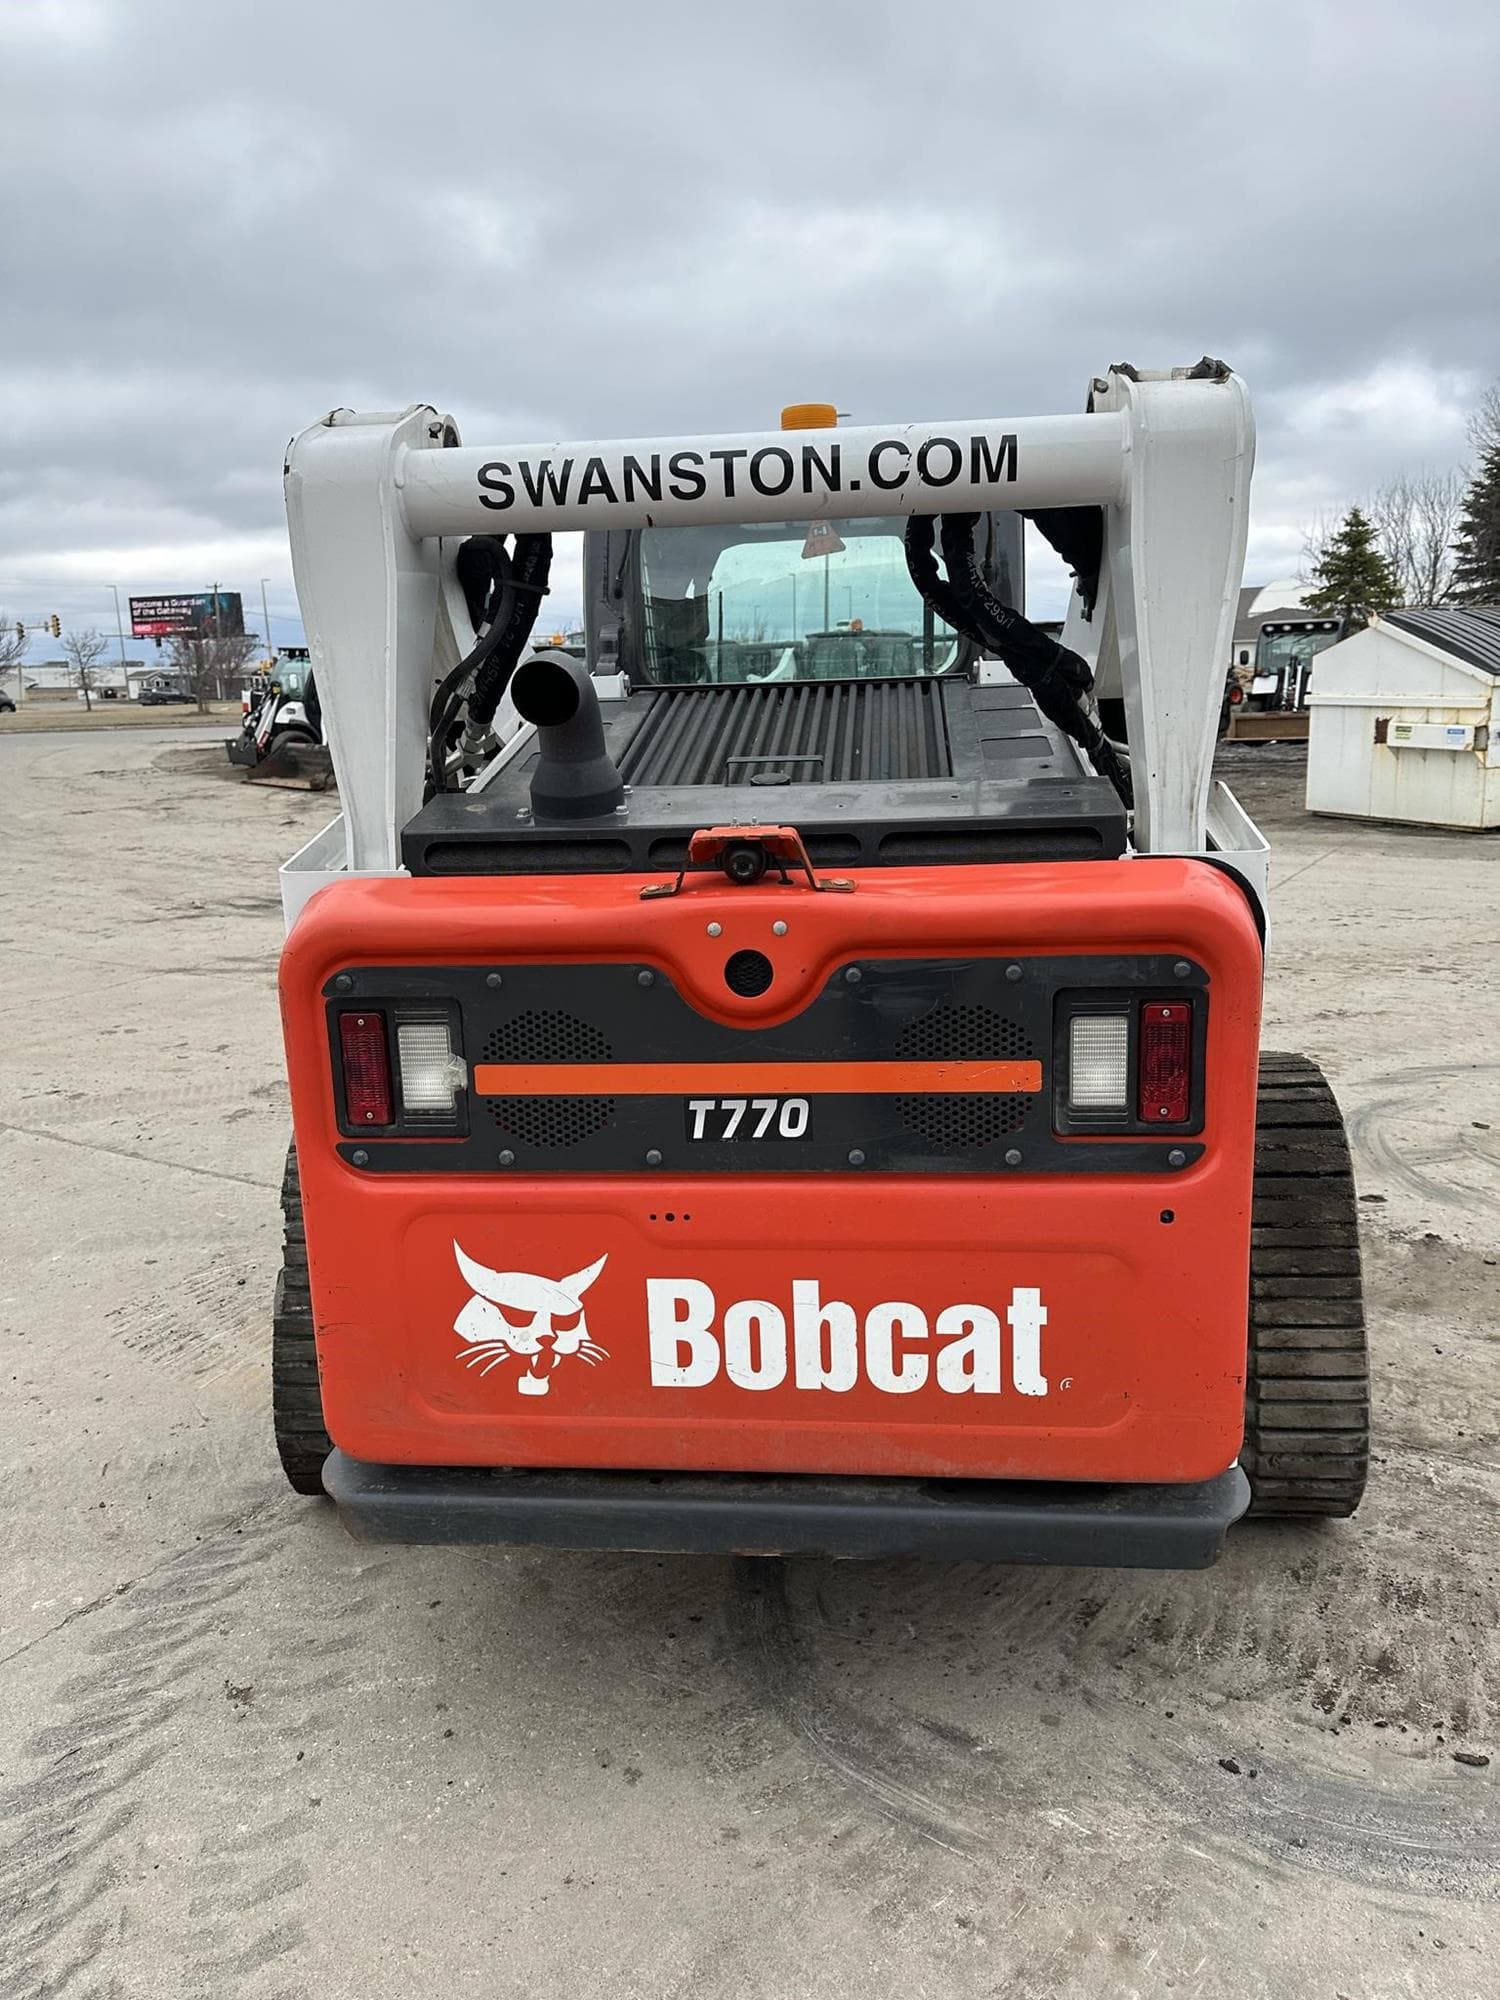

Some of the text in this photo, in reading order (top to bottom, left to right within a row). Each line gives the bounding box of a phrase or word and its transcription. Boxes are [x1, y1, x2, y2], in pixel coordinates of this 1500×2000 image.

[476, 434, 1018, 510] SWANSTON.COM
[131, 600, 163, 608] Become
[132, 608, 141, 616] of
[688, 1098, 809, 1139] T770
[646, 1277, 1048, 1396] Bobcat
